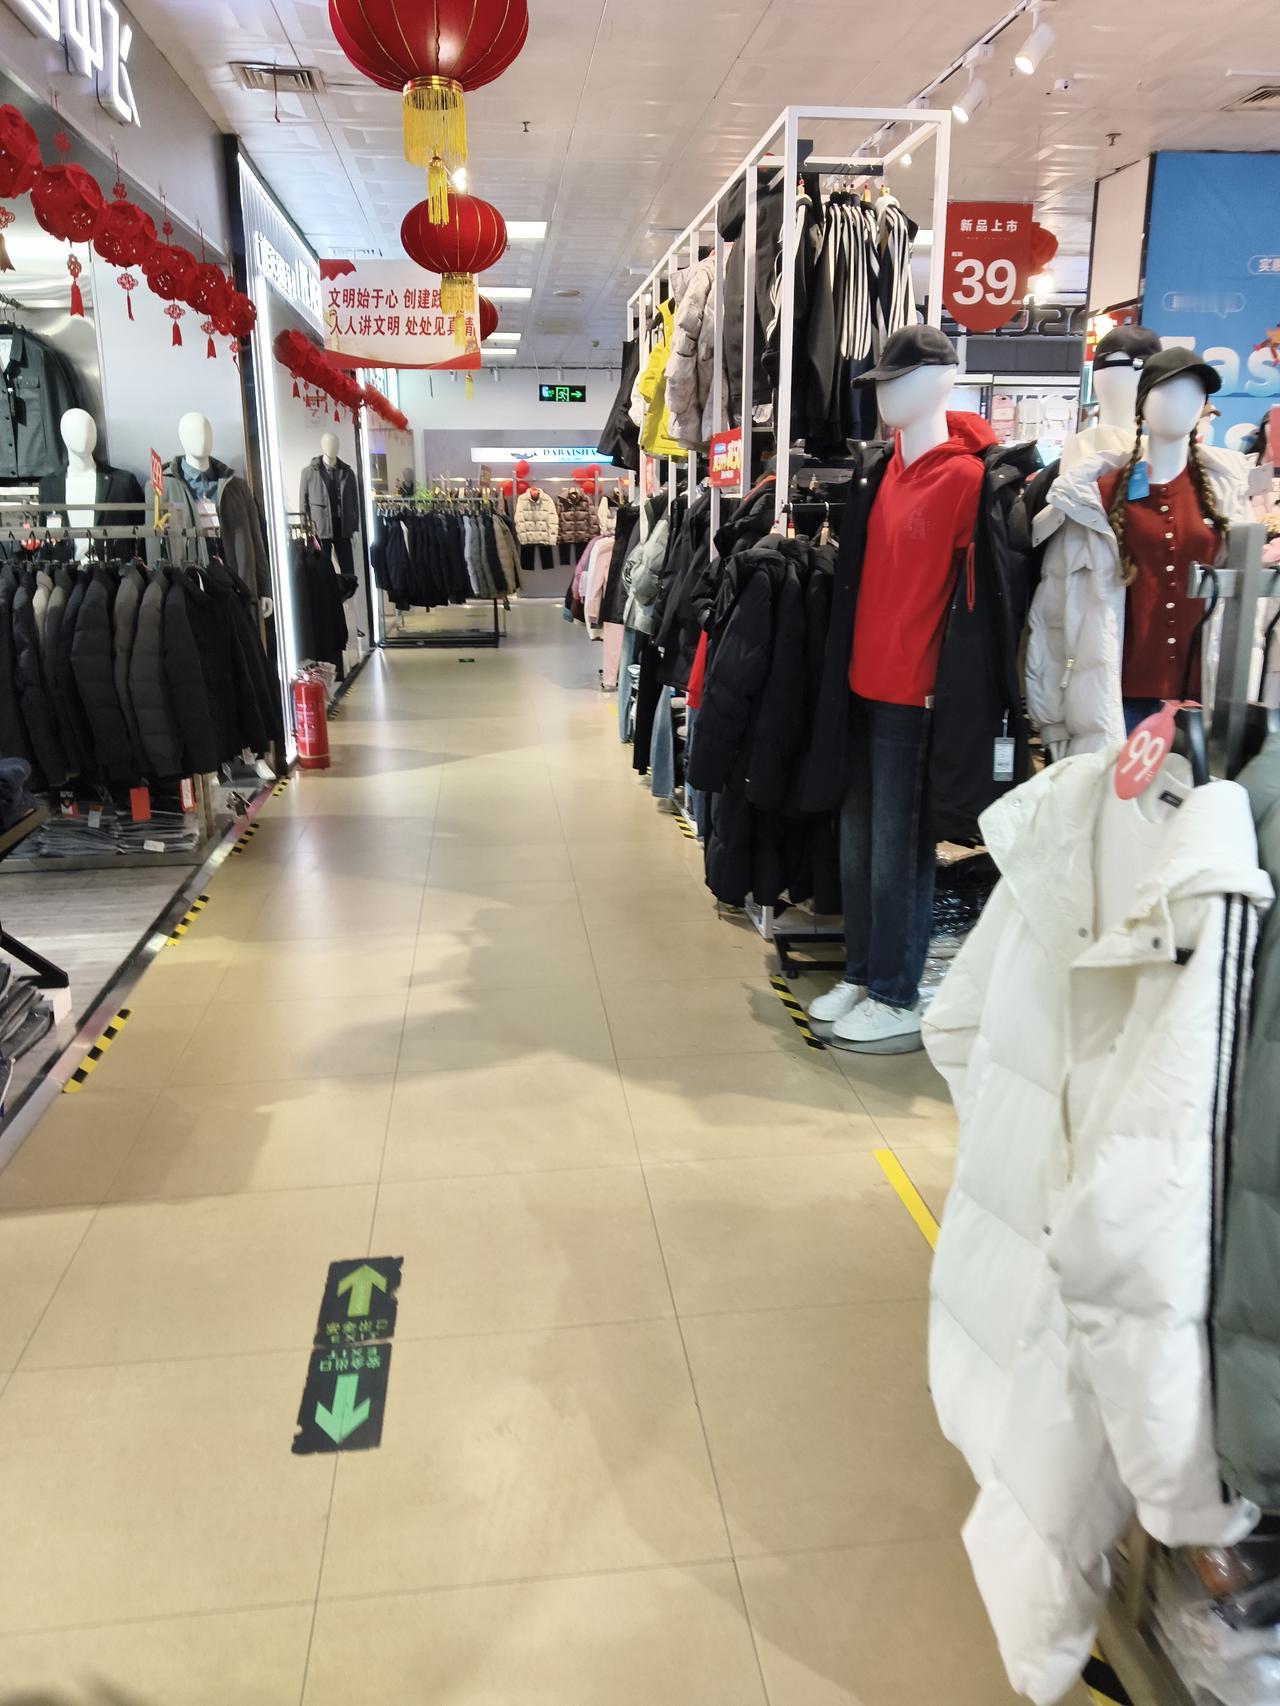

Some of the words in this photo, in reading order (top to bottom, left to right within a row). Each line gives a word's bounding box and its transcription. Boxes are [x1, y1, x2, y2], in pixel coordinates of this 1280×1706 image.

[960, 218, 1019, 233] 新品上市
[952, 258, 1017, 306] 39
[328, 287, 399, 310] 文明始于心
[330, 315, 401, 336] 人人讲文明
[1120, 730, 1166, 782] 99
